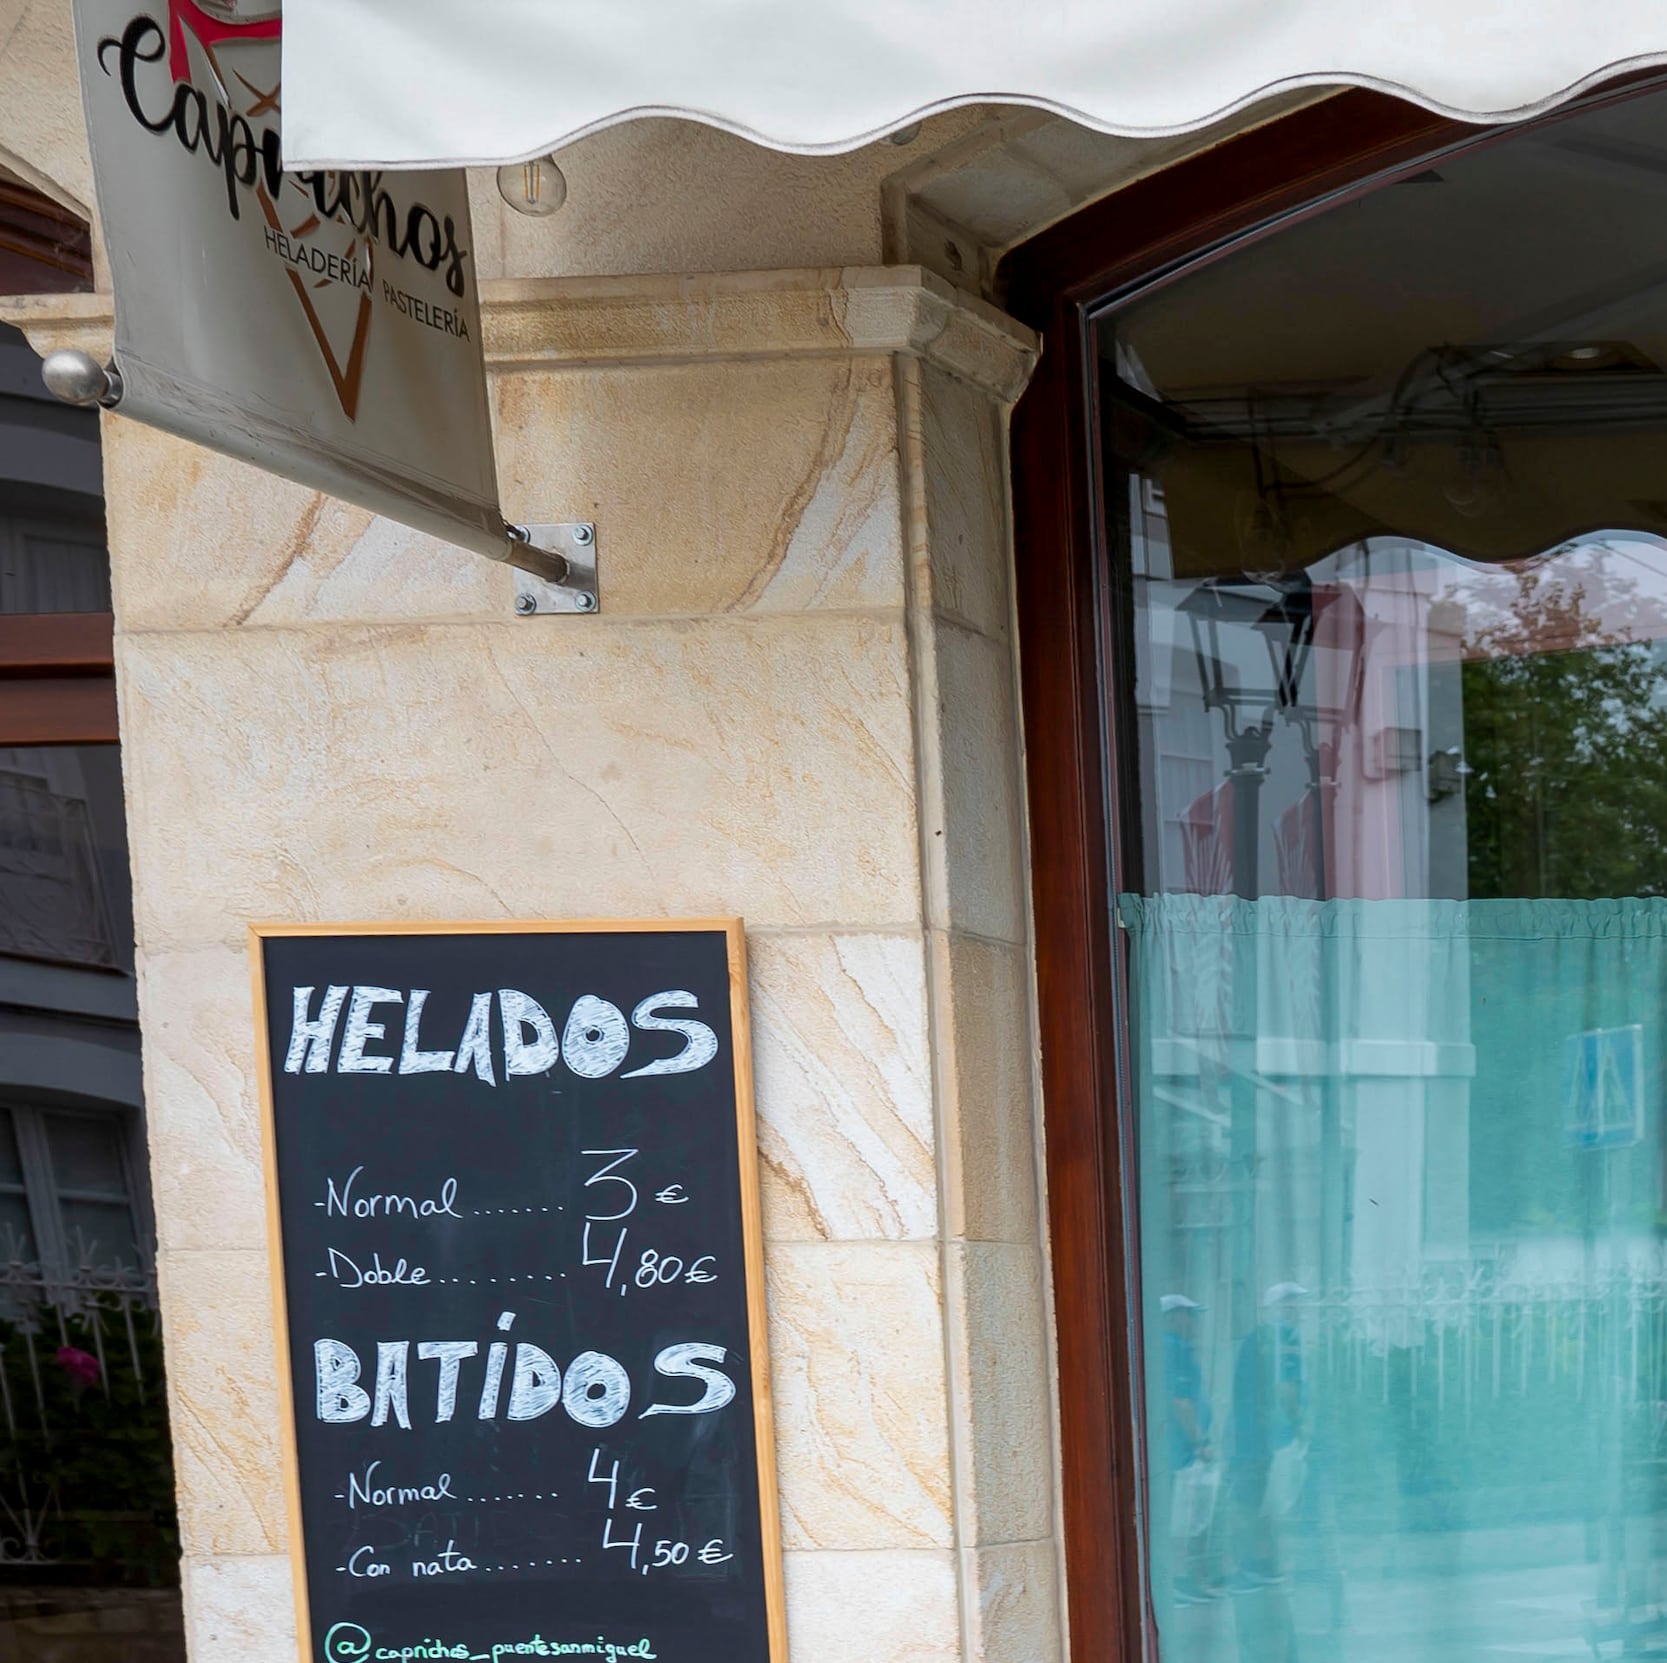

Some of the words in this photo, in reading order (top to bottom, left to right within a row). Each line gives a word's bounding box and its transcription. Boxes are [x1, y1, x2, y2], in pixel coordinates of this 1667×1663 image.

[264, 225, 372, 294] HELADERÍA
[382, 278, 470, 342] PASTELERÍA
[284, 983, 719, 1087] HELADOS
